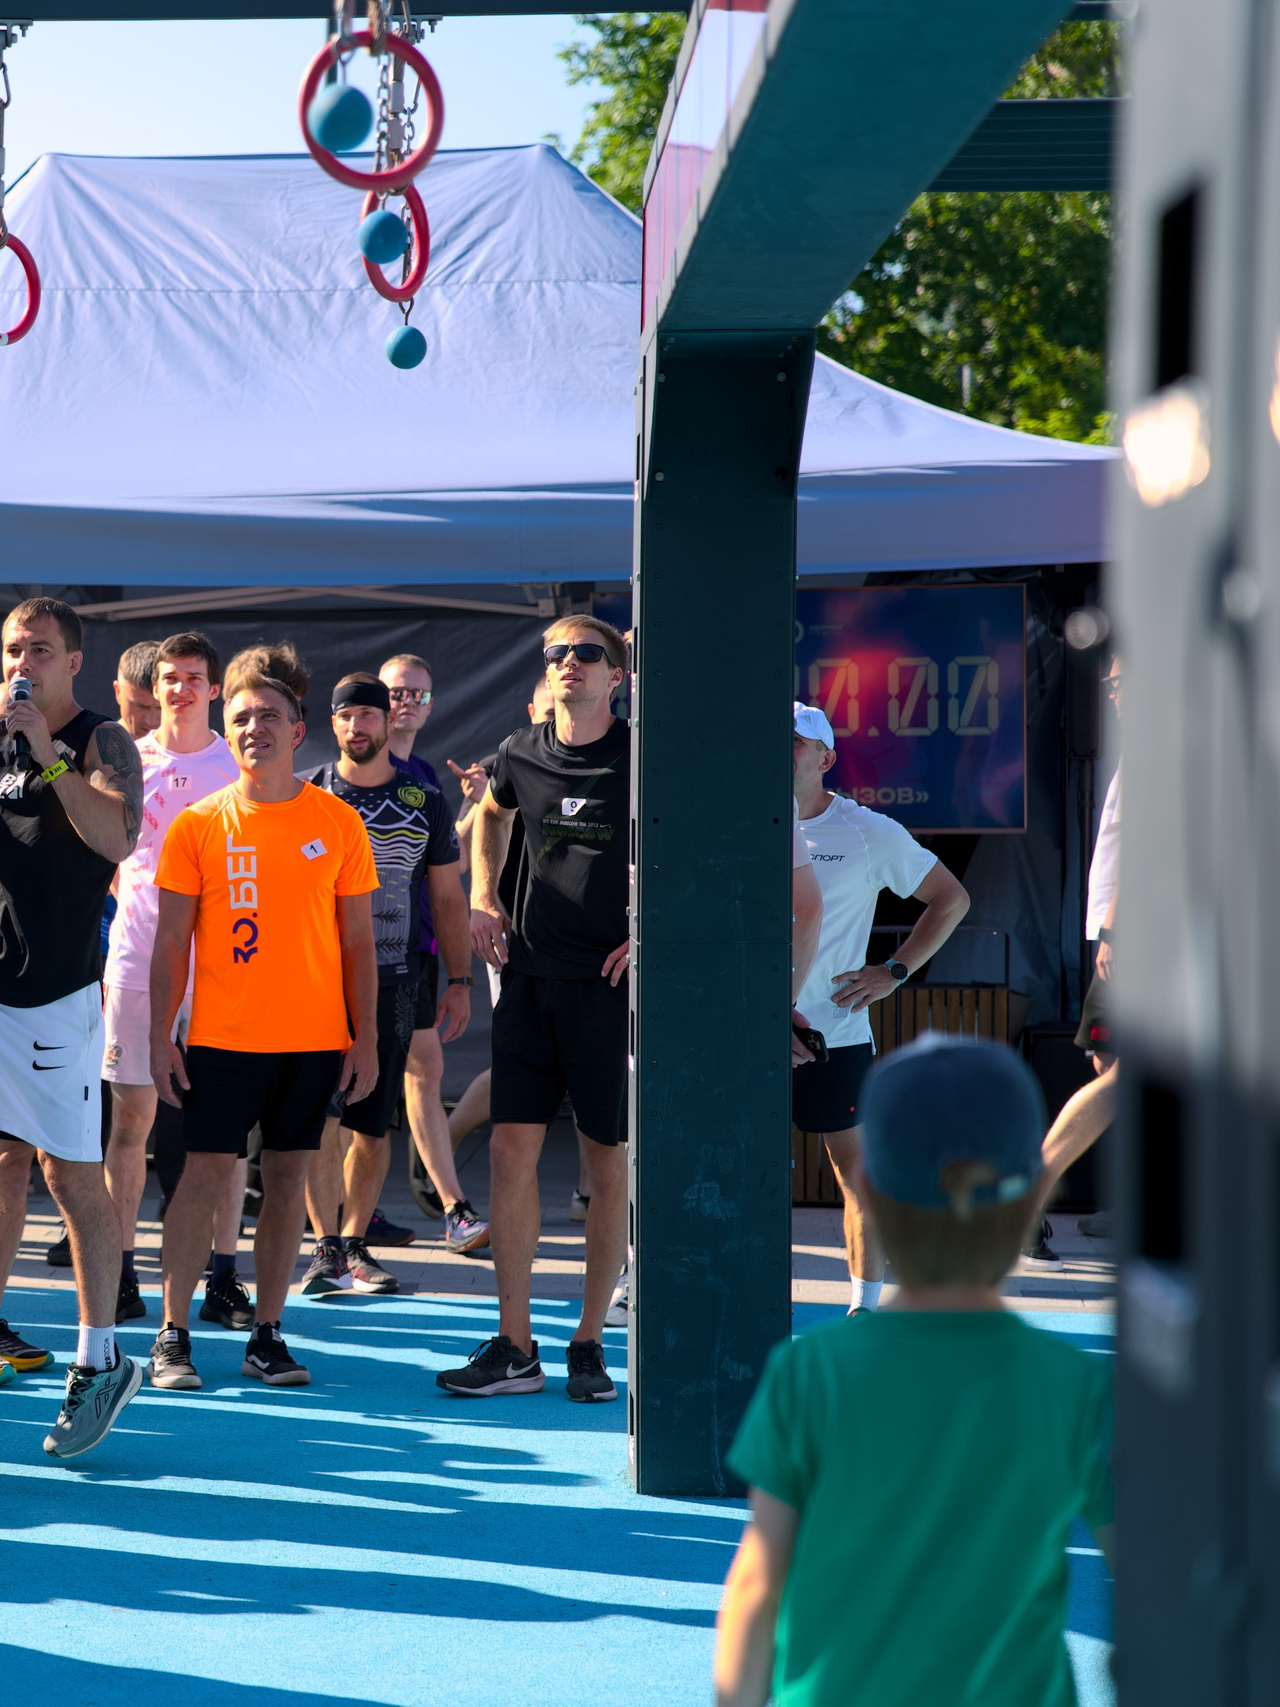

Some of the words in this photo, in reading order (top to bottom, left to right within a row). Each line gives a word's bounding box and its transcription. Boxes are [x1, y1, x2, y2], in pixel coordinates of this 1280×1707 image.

[794, 656, 999, 737] 0.00
[173, 777, 188, 788] 17
[824, 786, 930, 805] ЫЗОВ»
[309, 844, 318, 854] 1
